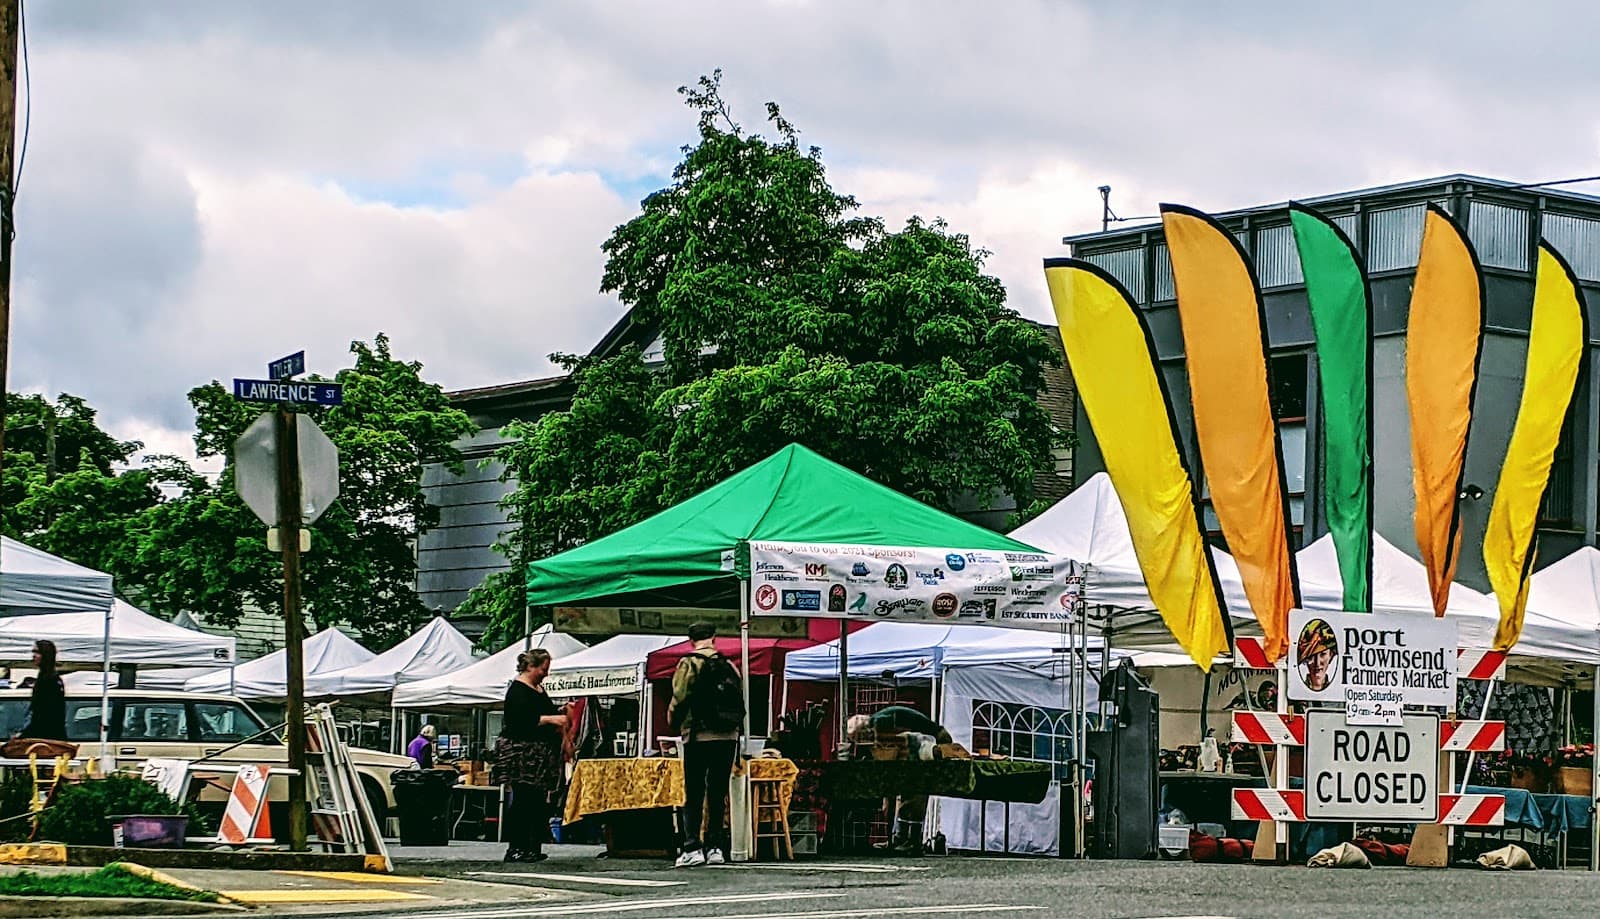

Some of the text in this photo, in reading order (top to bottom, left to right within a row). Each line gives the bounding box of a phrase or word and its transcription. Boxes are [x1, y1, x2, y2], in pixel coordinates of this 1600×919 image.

[273, 359, 293, 379] TYLER
[239, 383, 336, 402] LAWRENCE ST
[868, 548, 916, 559] Sponsors!
[1344, 627, 1406, 655] port
[1359, 646, 1444, 670] townsend
[1341, 656, 1450, 689] Farmers Market
[1347, 689, 1403, 704] Open Saturdays
[1334, 730, 1410, 762] ROAD
[1316, 771, 1426, 804] CLOSED
